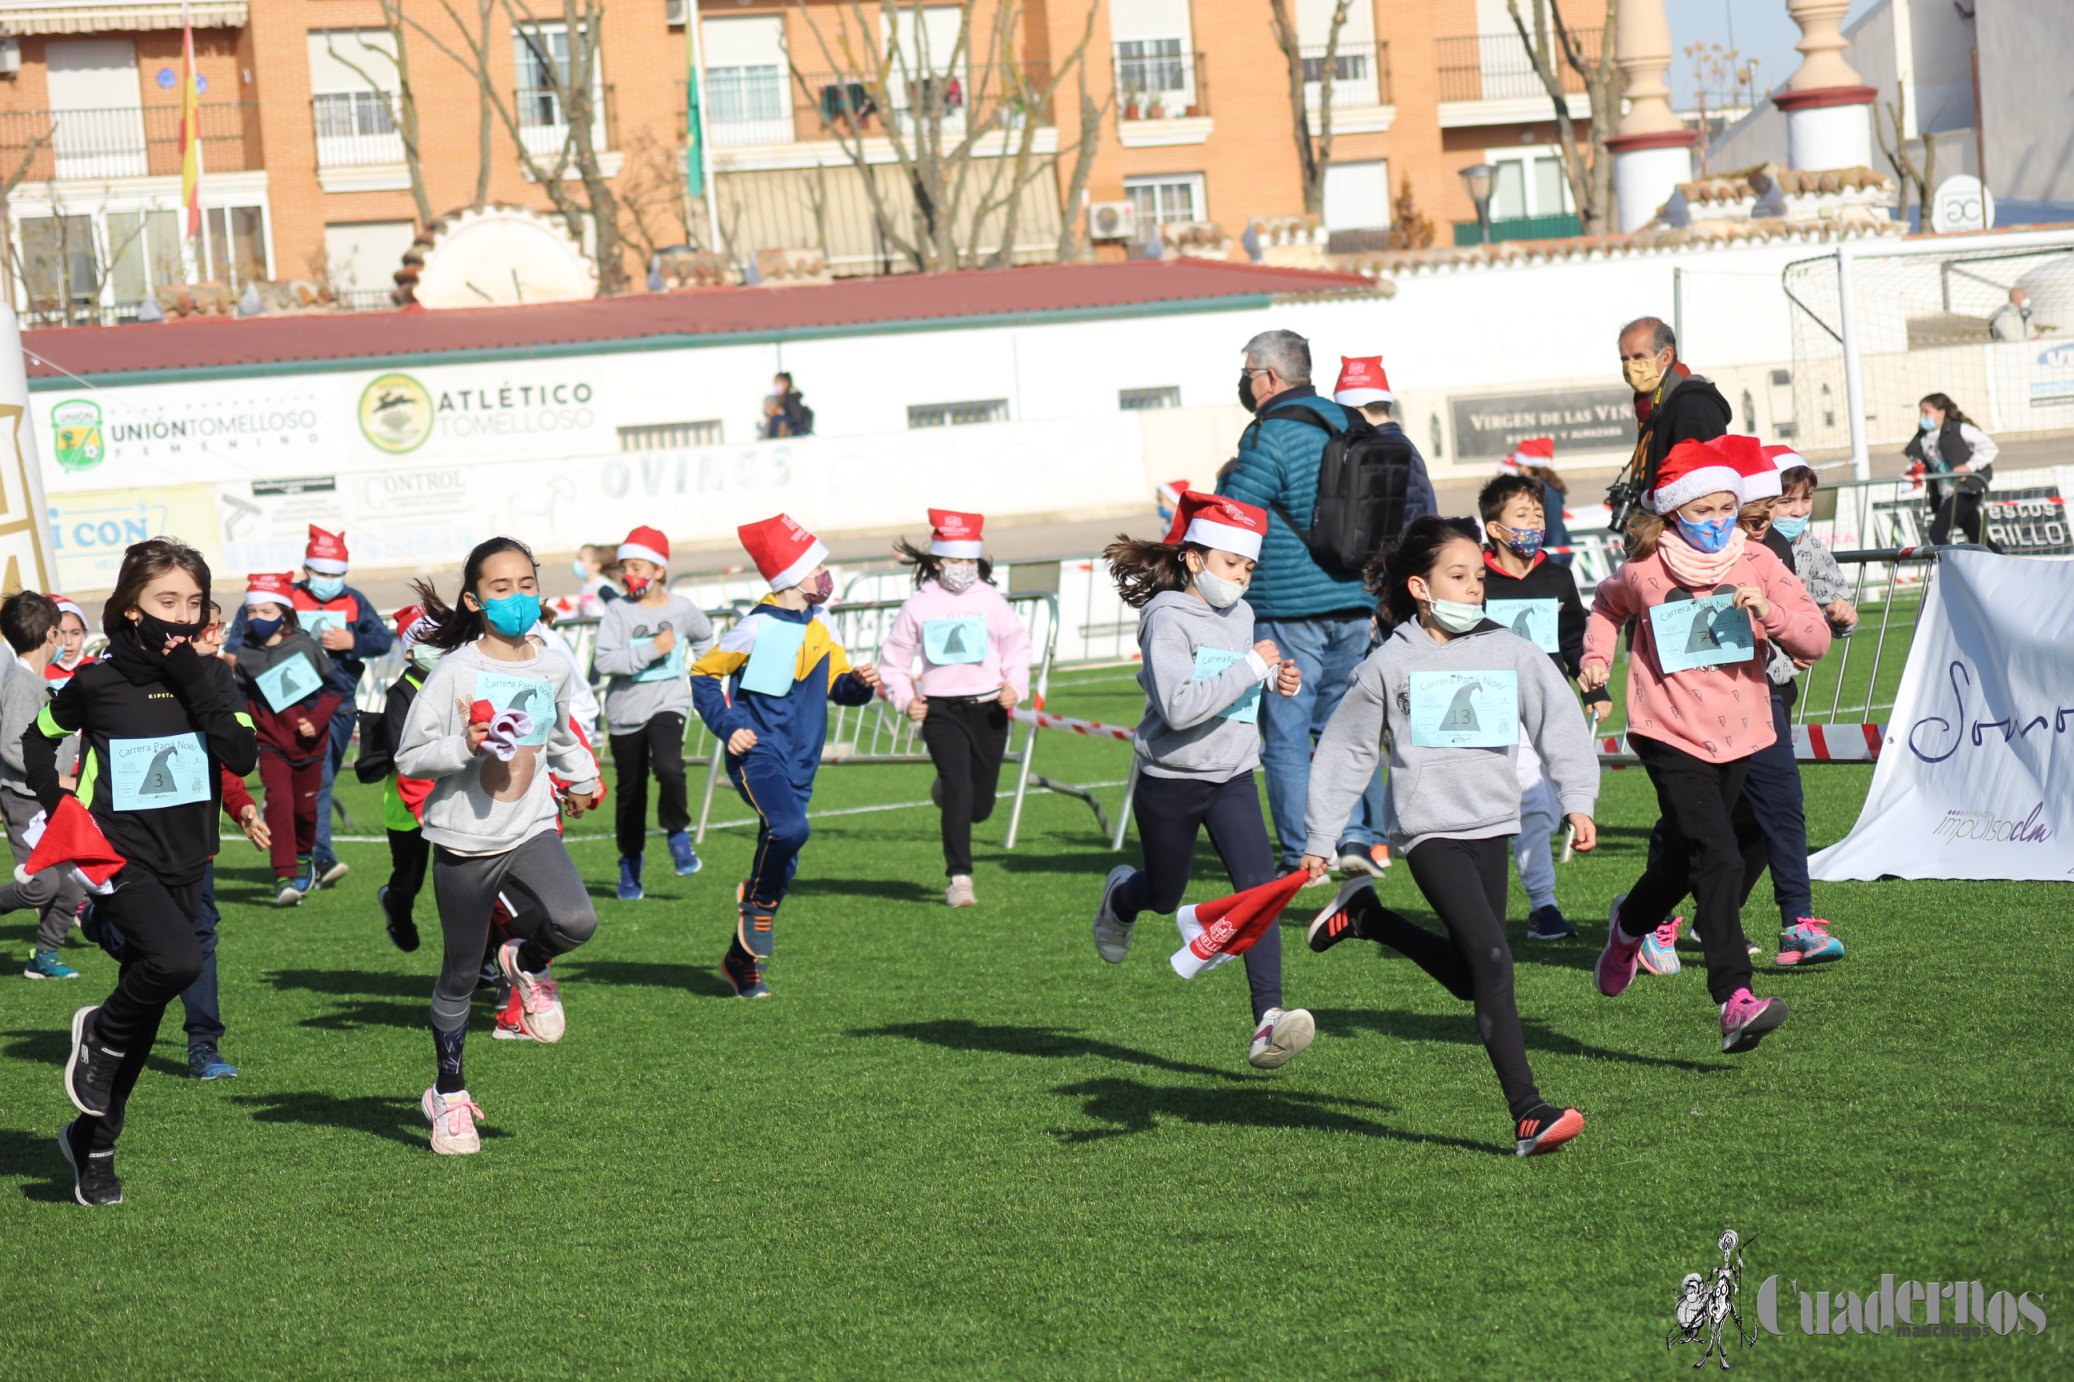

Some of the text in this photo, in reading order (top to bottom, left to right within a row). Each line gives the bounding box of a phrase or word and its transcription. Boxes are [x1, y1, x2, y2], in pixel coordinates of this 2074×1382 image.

[438, 382, 593, 412] ATLÉTICO
[438, 408, 596, 437] TOMELLOSO
[1470, 412, 1535, 431] VIRGEN
[1539, 410, 1562, 427] DE
[1565, 408, 1592, 425] LAS
[1988, 522, 2065, 547] RILLO
[1660, 606, 1691, 622] Carrera
[485, 679, 516, 689] Carrera
[1419, 676, 1455, 691] Carrera
[1450, 708, 1472, 725] 13
[118, 743, 151, 758] Carrera
[178, 740, 199, 752] Noel
[154, 773, 164, 788] 3
